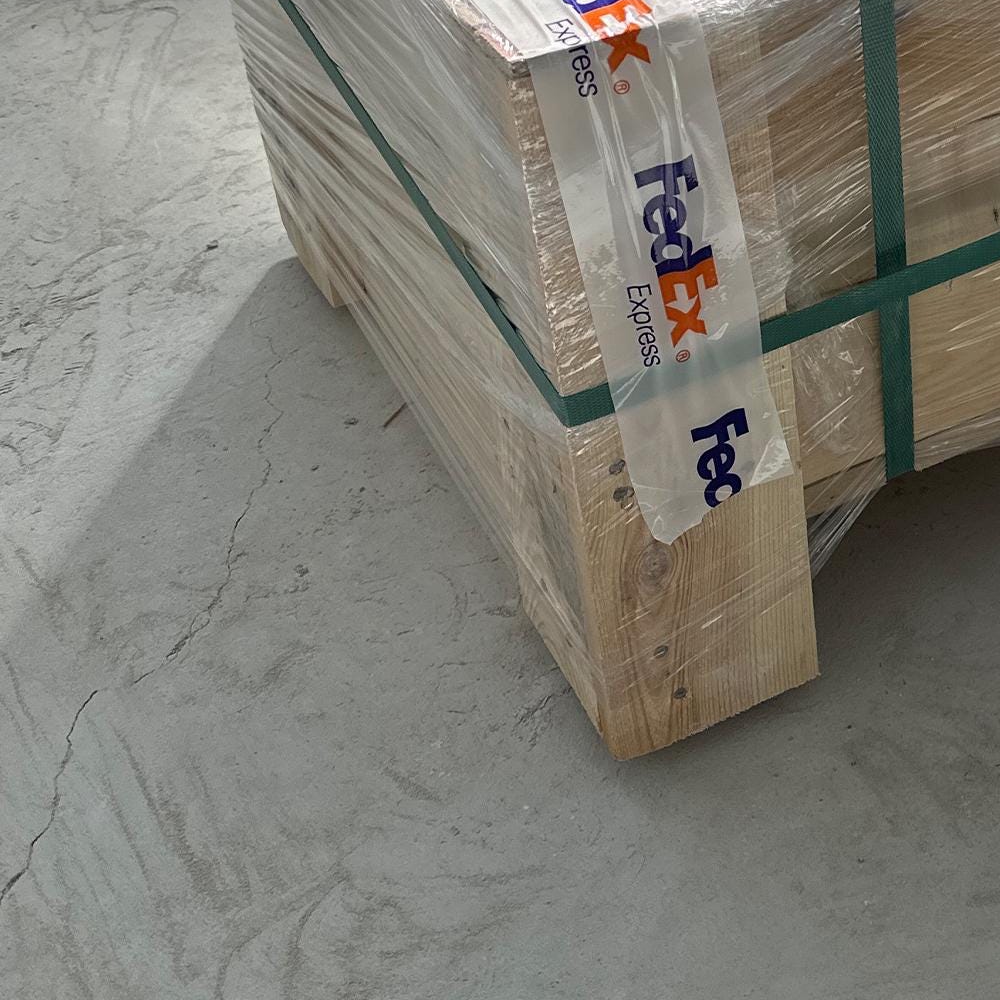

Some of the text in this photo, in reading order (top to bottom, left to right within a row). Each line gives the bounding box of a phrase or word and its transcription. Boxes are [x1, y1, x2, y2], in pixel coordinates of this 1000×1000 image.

[545, 17, 599, 98] Express
[634, 154, 719, 349] FedEx
[626, 283, 661, 369] Express
